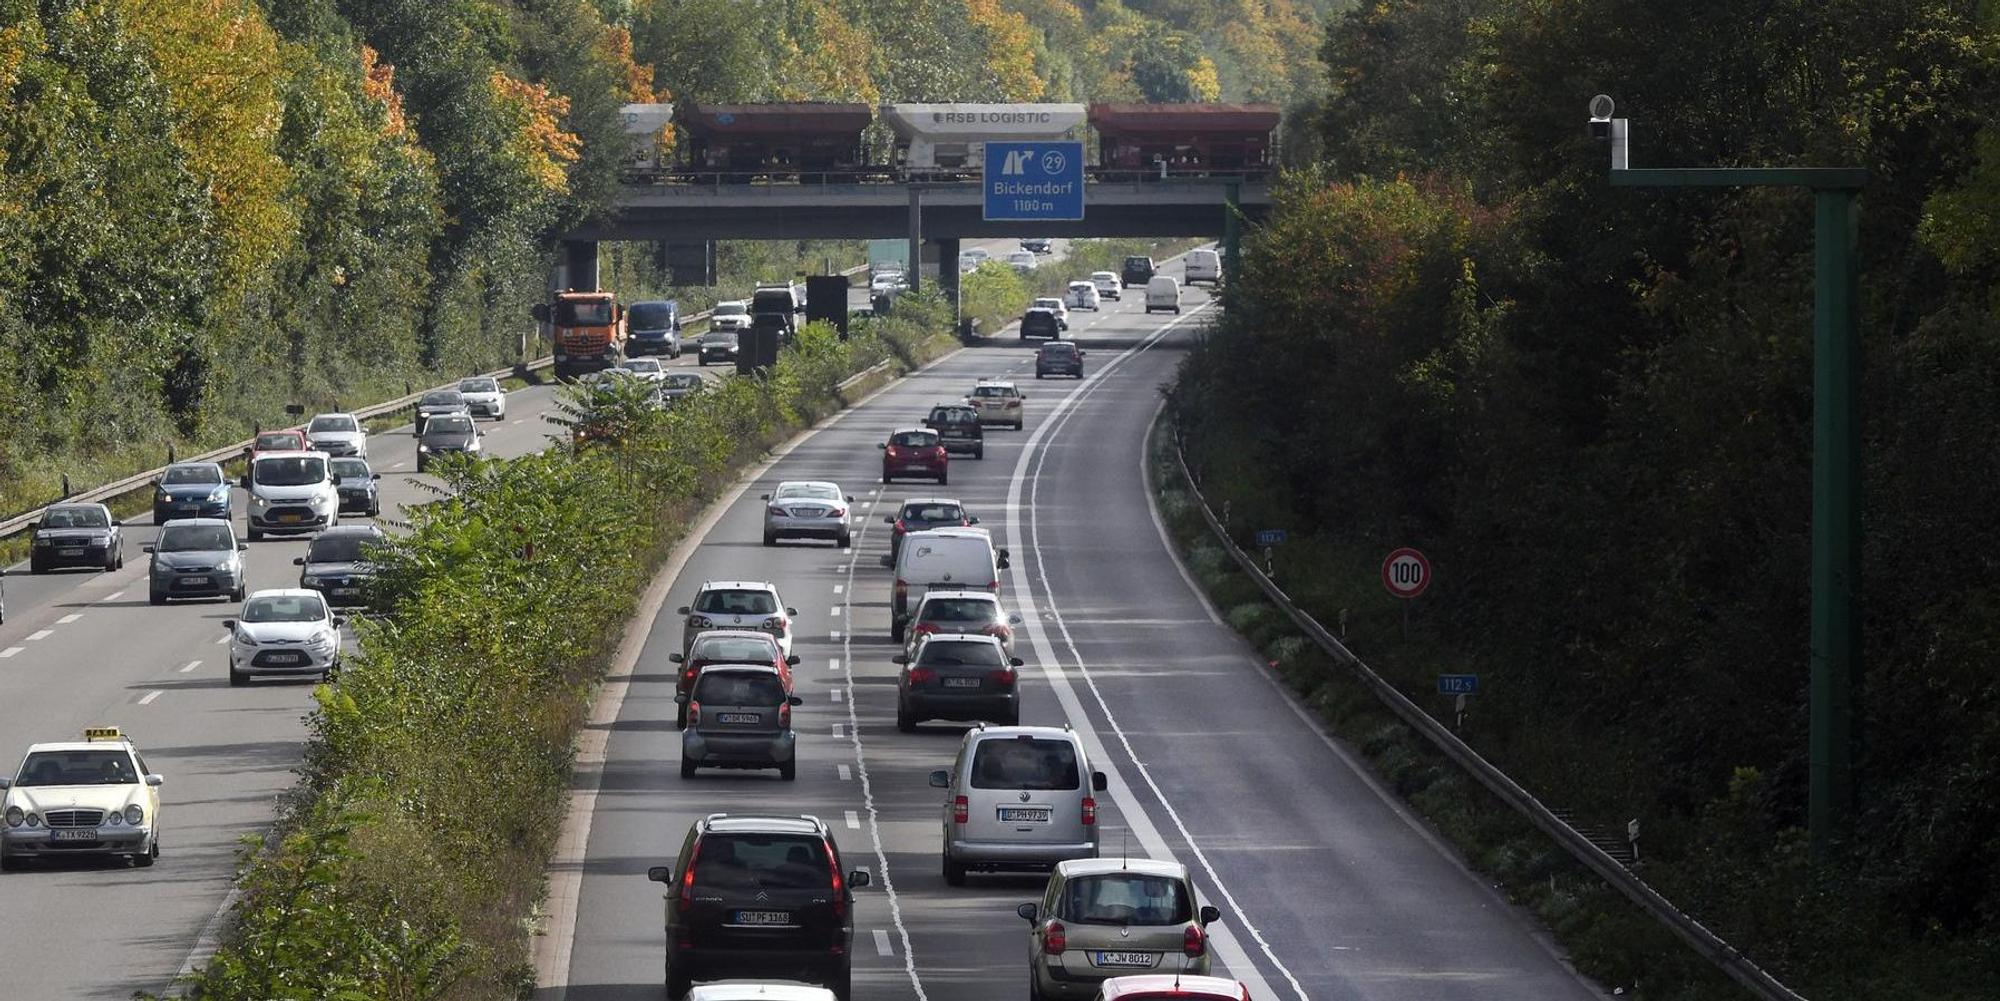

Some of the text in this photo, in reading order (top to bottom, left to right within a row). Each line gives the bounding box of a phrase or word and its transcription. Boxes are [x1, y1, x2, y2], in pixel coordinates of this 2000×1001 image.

[945, 112, 1050, 124] RSB LOGISTIC
[1045, 157, 1063, 170] 29
[993, 181, 1074, 195] Bickendorf
[1014, 199, 1054, 211] 1100 m
[1392, 562, 1421, 584] 100
[1129, 954, 1151, 963] 8012
